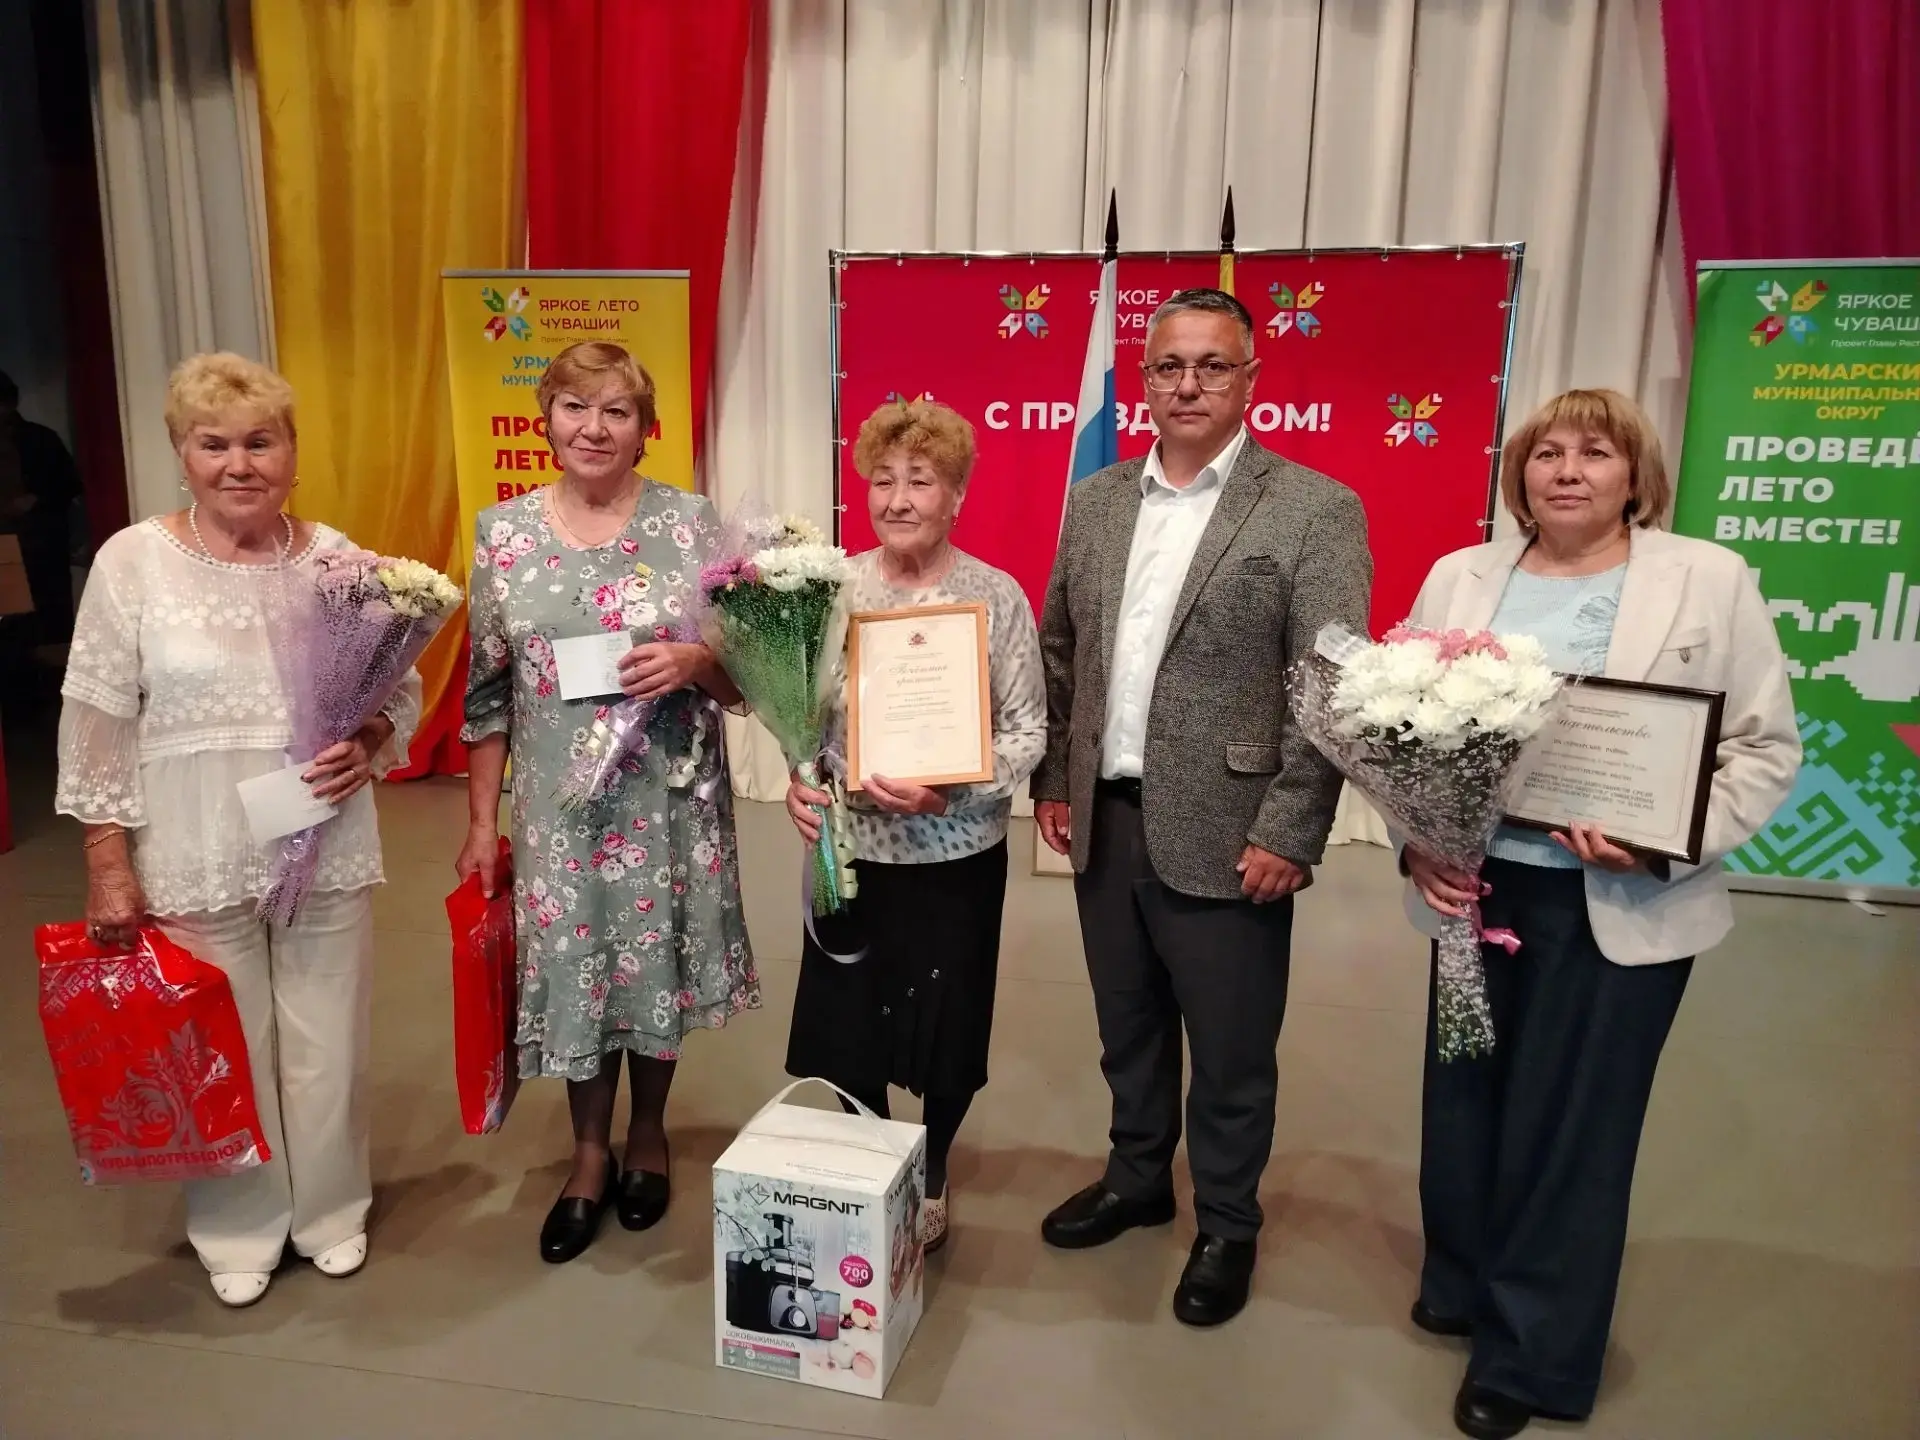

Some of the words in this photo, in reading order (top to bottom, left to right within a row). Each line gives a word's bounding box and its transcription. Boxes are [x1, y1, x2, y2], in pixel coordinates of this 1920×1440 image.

[1089, 290, 1160, 305] ЯКОЕ
[1837, 294, 1913, 309] ЯРКОЕ
[539, 300, 590, 312] ЯРКОЕ
[597, 300, 640, 312] ЛЕТО
[540, 317, 620, 330] ЧУВАШИИ
[1834, 316, 1920, 331] ЧУВАШ
[1131, 337, 1147, 345] Гла
[984, 401, 1010, 430] С
[1816, 405, 1886, 420] ОКРУГ
[1718, 475, 1834, 503] ЛЕТО
[1714, 515, 1902, 545] ВМЕСТЕ!
[773, 1191, 865, 1216] MAGNIT
[843, 1265, 869, 1280] 700
